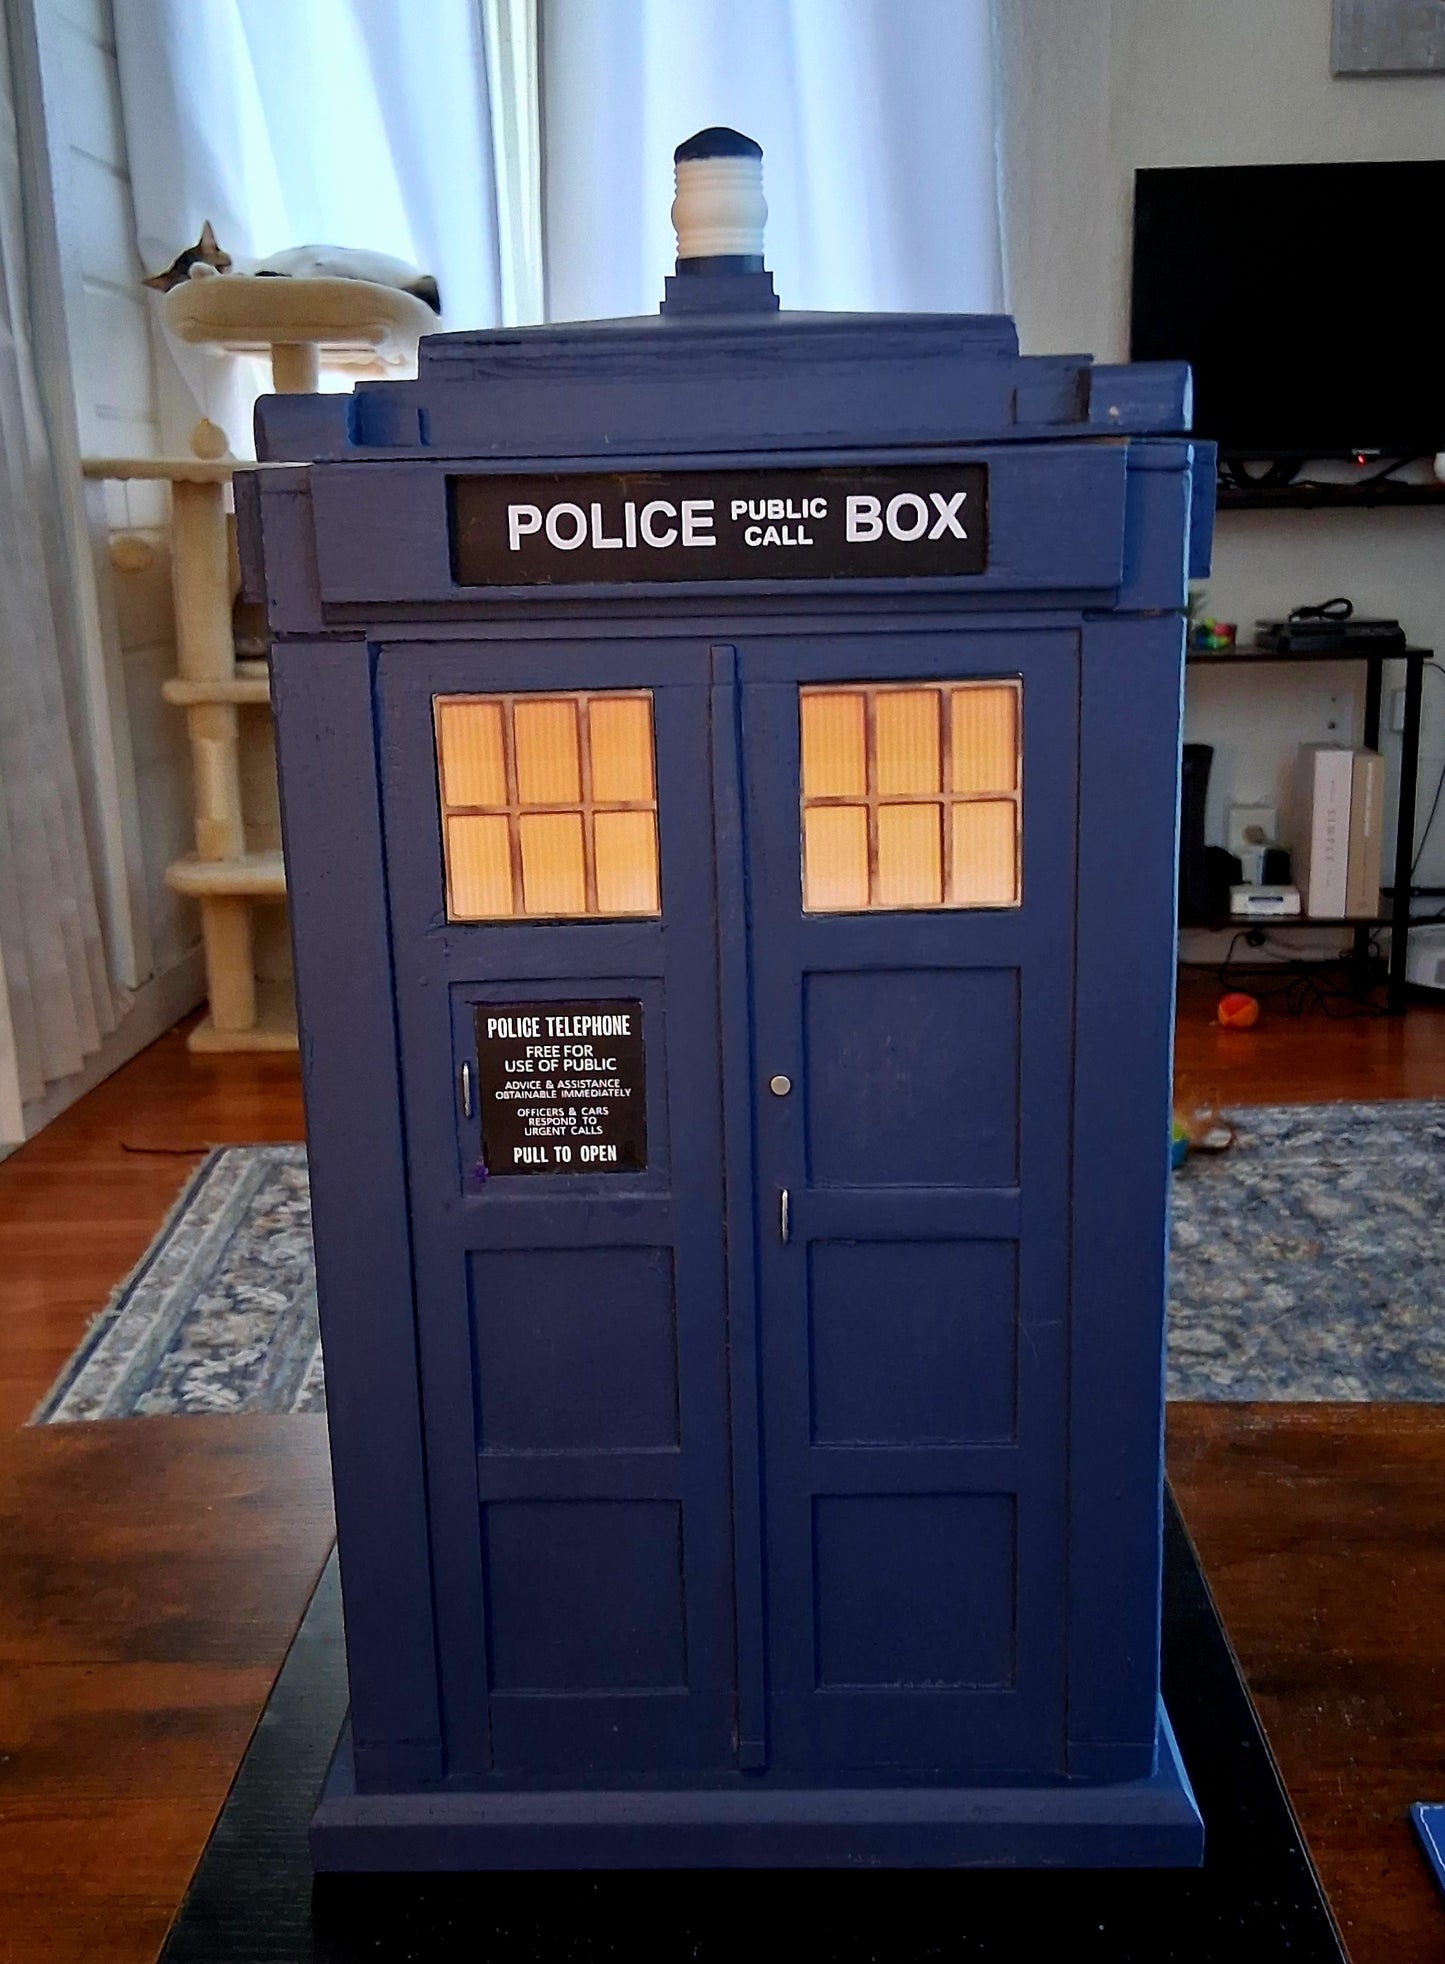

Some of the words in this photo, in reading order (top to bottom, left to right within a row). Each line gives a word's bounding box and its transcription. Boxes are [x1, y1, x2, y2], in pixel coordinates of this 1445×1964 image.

[731, 498, 827, 520] PUBLIC
[846, 492, 967, 542] BOX
[508, 500, 716, 550] POLICE
[745, 525, 813, 546] CALL
[488, 1017, 541, 1038] POLICE
[545, 1015, 631, 1036] TELEPHONE
[526, 1045, 560, 1058] FREE
[564, 1045, 593, 1057] FOR
[505, 1060, 534, 1072] USE
[539, 1059, 558, 1071] OF
[564, 1058, 617, 1071] PUBLIC
[505, 1081, 541, 1089] ADVICE
[546, 1080, 554, 1089] &
[557, 1079, 620, 1089] ASSISTANCE
[496, 1091, 557, 1099] OBTAINABLE
[562, 1088, 631, 1097] IMMEDIATELY
[517, 1108, 564, 1117] OFFICERS
[569, 1107, 576, 1115] &
[581, 1107, 609, 1115] CARS
[529, 1117, 576, 1126] RESPOND
[583, 1117, 597, 1125] TO
[525, 1127, 566, 1136] URGENT
[571, 1126, 603, 1135] CALLS
[514, 1147, 549, 1163] PULL
[554, 1146, 571, 1162] TO
[581, 1145, 616, 1162] OPEN
